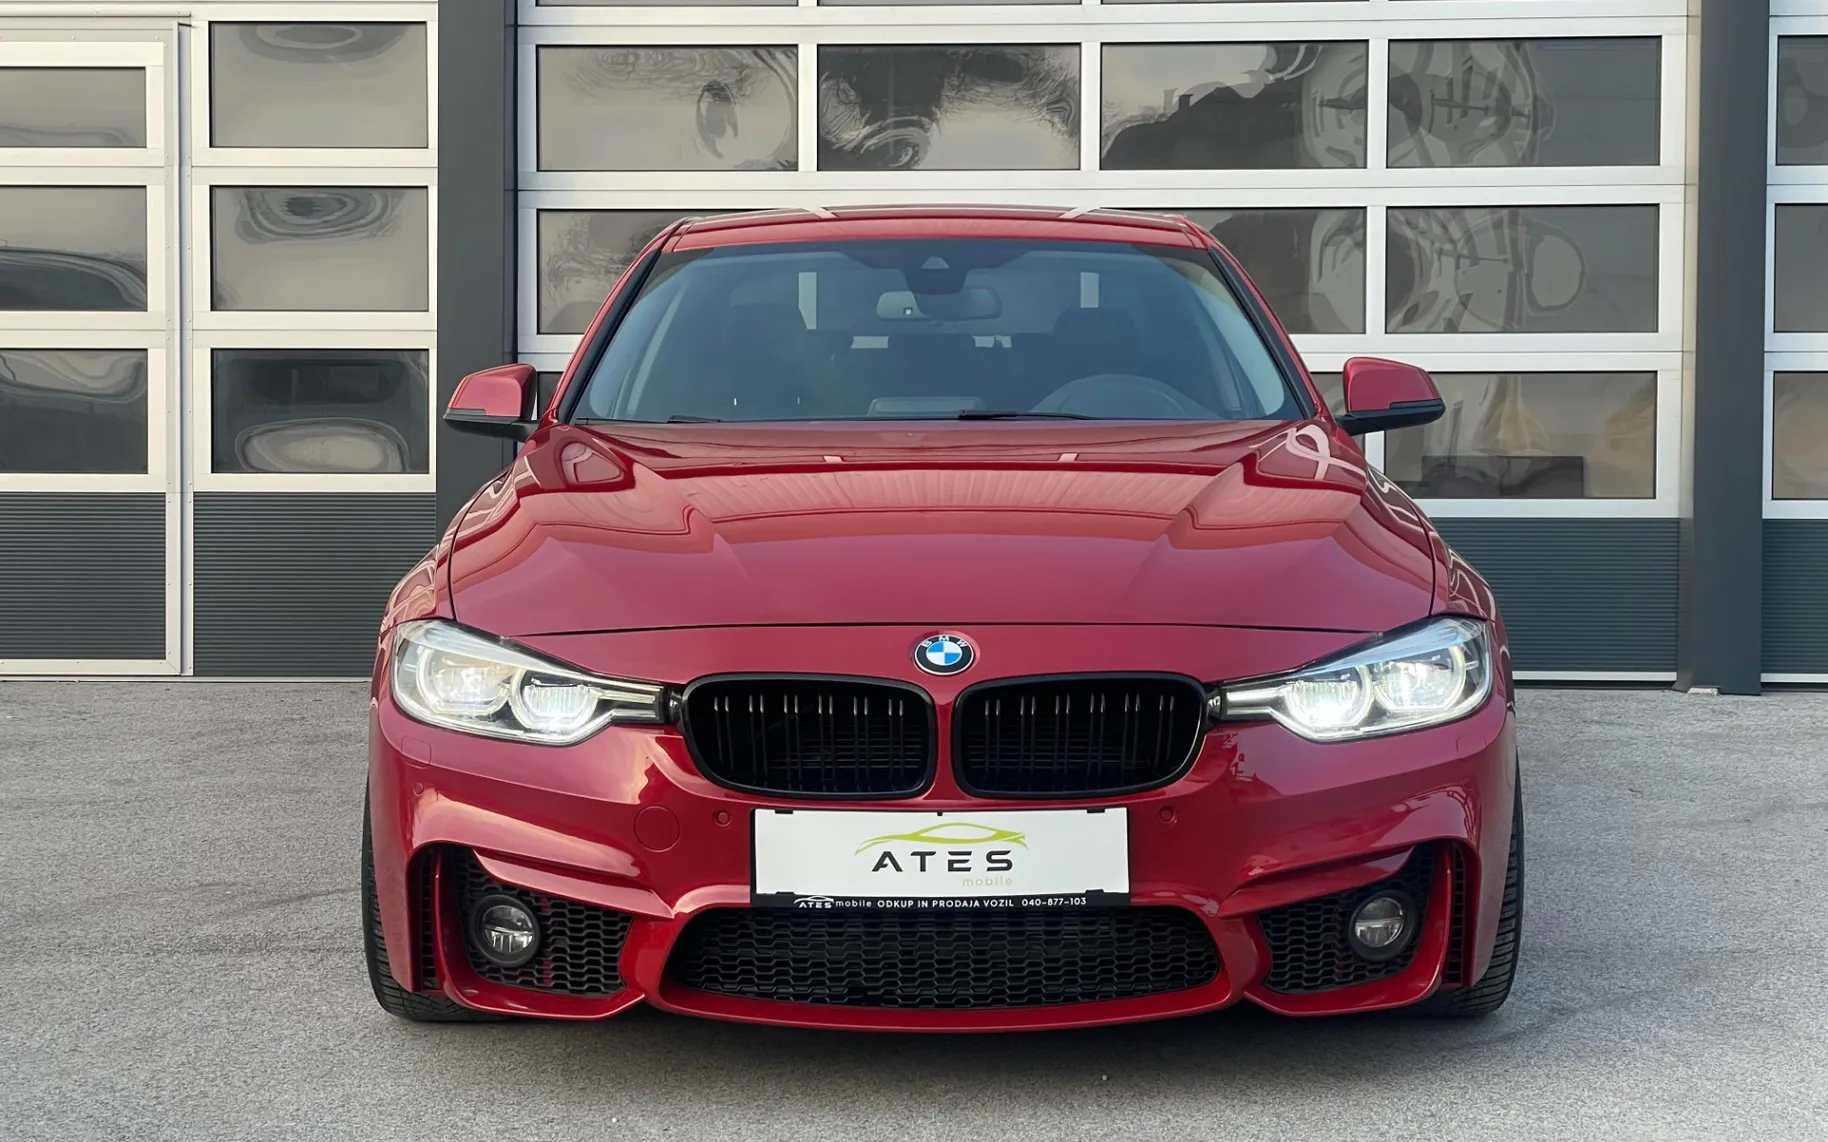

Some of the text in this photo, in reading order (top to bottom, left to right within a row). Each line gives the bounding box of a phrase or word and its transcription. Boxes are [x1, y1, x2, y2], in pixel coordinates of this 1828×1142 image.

[921, 635, 968, 648] BMW
[871, 850, 1013, 872] ATES
[962, 875, 1013, 886] mobile
[798, 897, 1087, 909] ATES mobile ODKUP IN PRODAJA VOZIL 040-877-103
